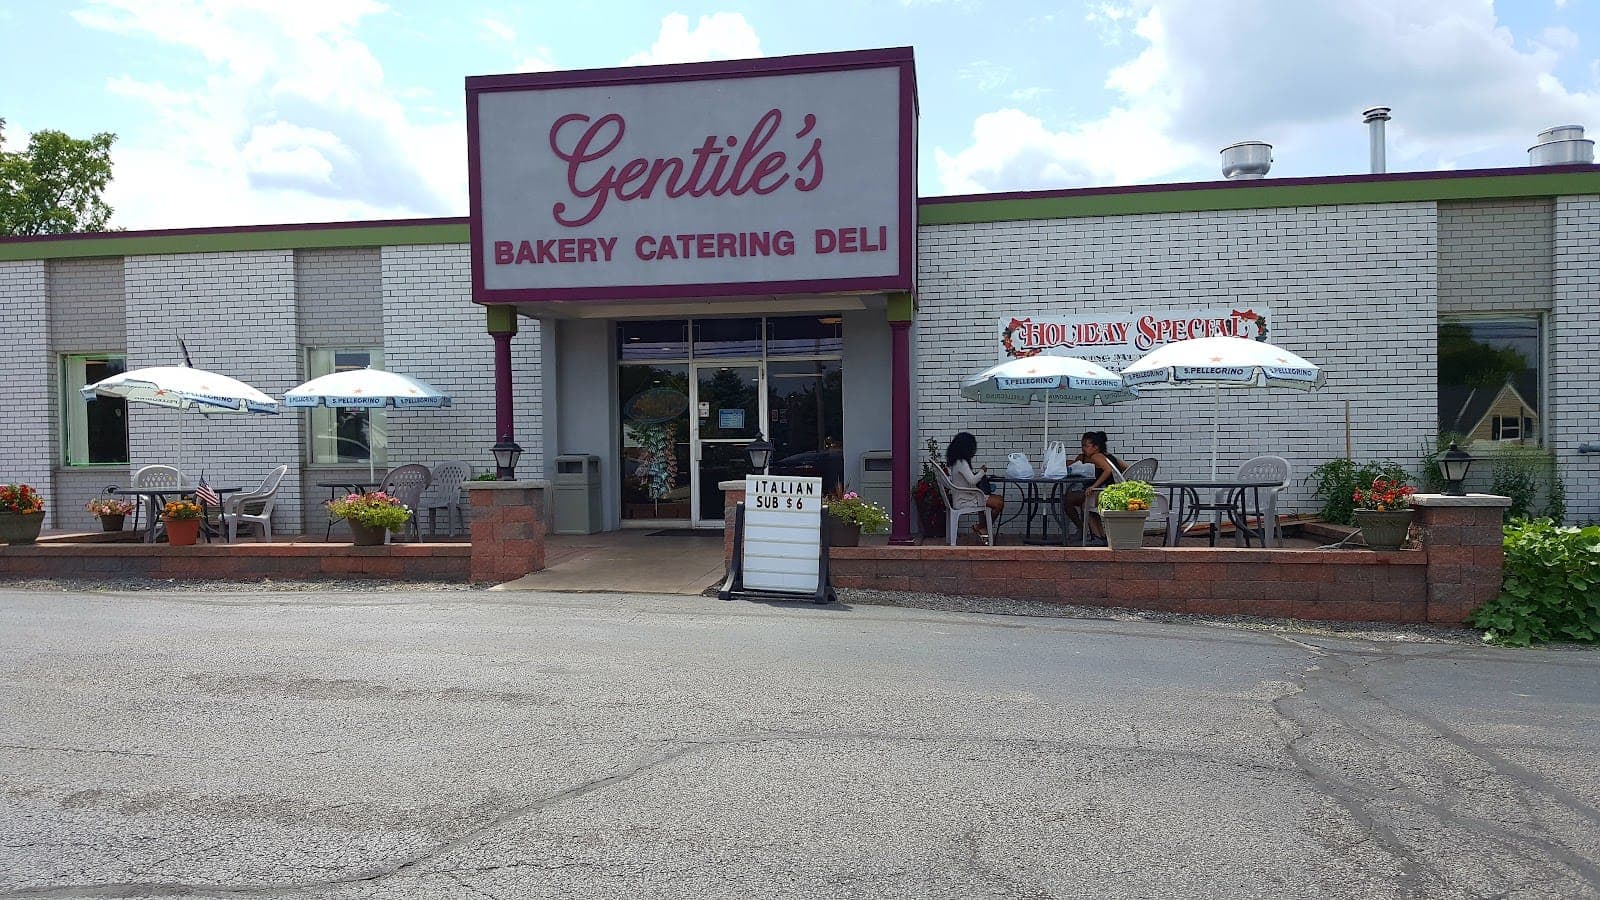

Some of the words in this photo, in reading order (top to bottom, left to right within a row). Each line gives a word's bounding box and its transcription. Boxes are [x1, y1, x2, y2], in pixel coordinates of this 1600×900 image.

[549, 108, 824, 227] Gentile's
[494, 237, 617, 265] BAKERY
[635, 230, 795, 261] CATERING
[815, 226, 887, 254] DELI
[1019, 321, 1130, 349] HOLIDAY
[1135, 315, 1249, 351] SPECIAL
[1184, 367, 1244, 376] S.PELLEGRINO
[1005, 377, 1054, 386] S.PELLEGRINO
[756, 480, 813, 495] ITALIAN
[756, 495, 779, 509] SUB
